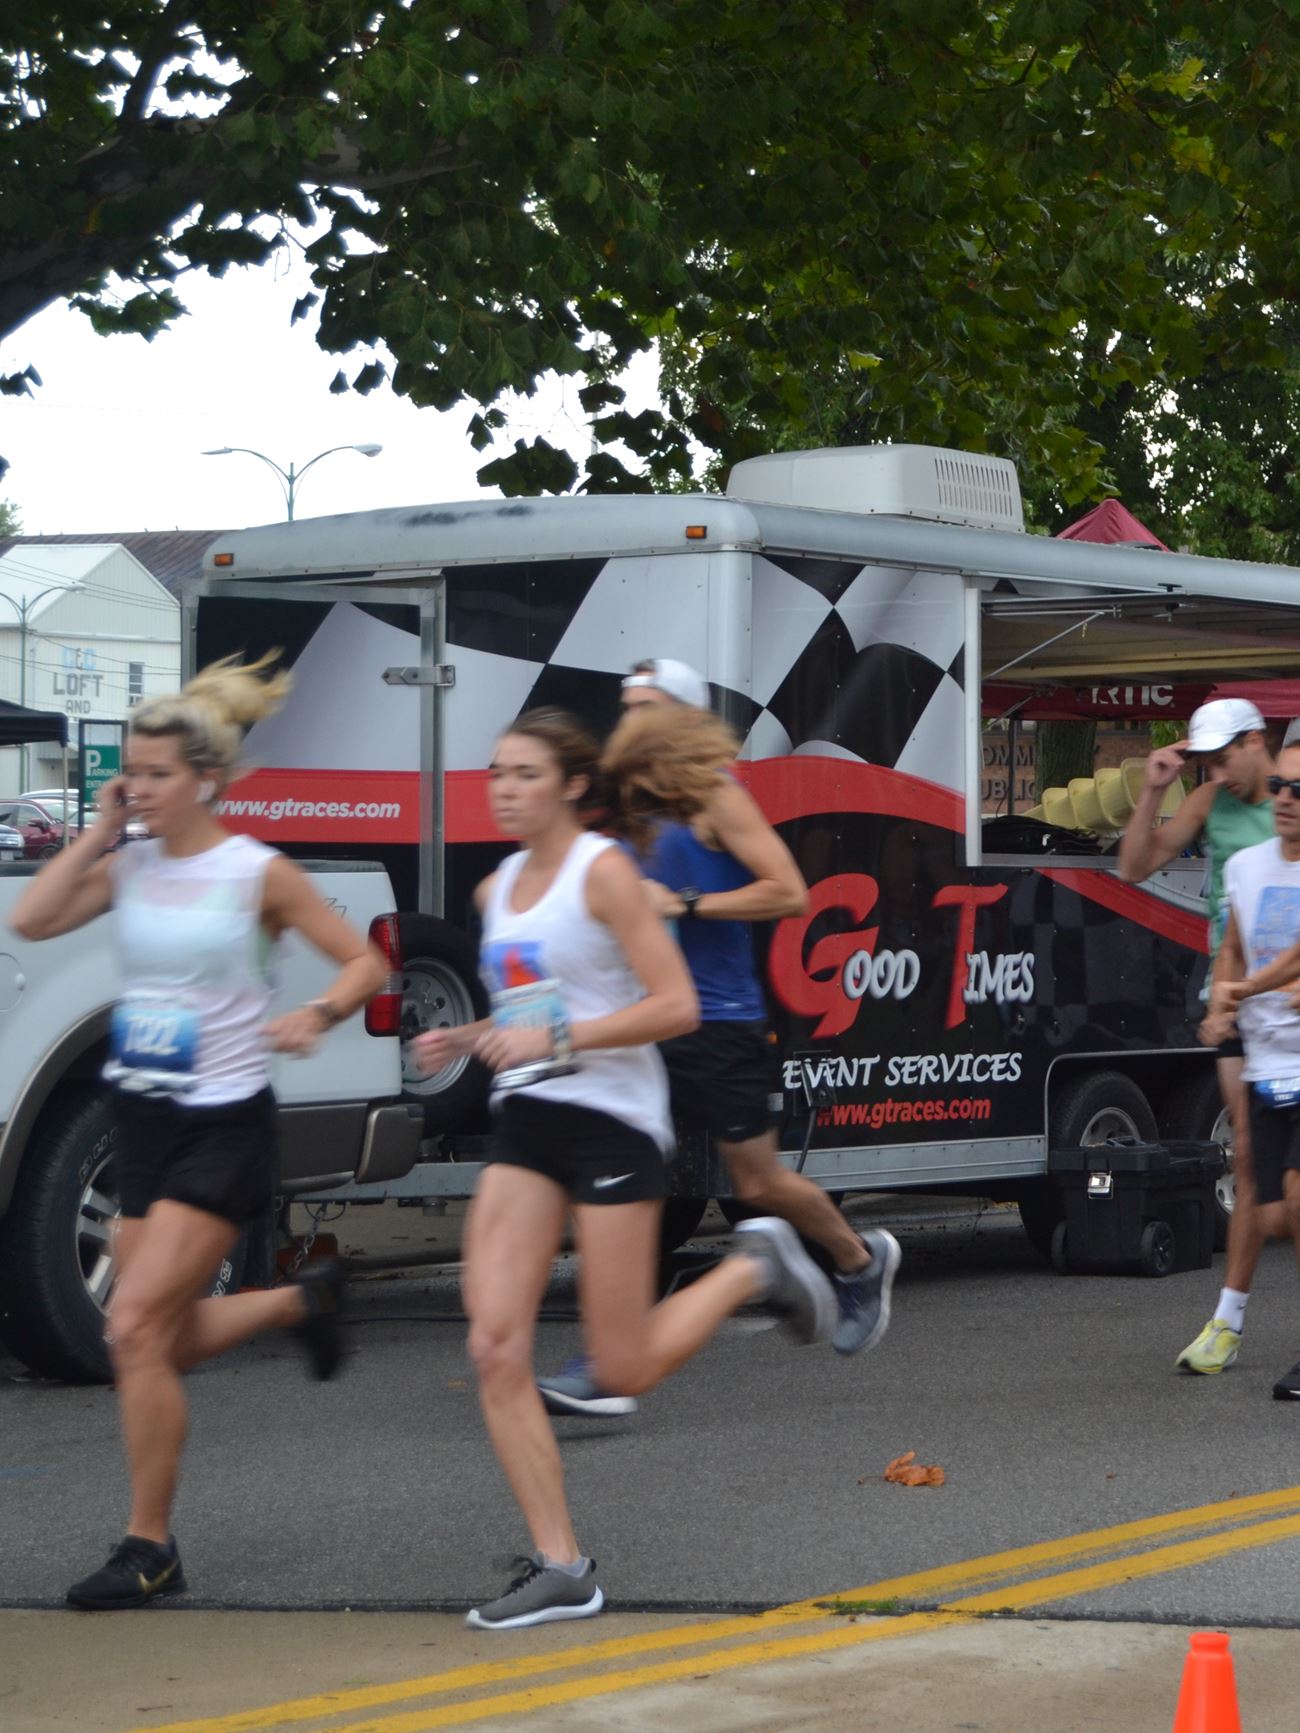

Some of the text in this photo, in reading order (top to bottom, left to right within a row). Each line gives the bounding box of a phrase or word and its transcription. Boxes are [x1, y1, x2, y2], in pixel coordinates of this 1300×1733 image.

[53, 672, 103, 697] LOFT
[65, 699, 92, 714] AND
[86, 749, 119, 777] PARKING
[211, 798, 400, 820] www.gtraces.com
[768, 872, 1035, 1039] GOOD TIMES
[782, 1052, 1022, 1089] EVENT SERVICES
[816, 1098, 991, 1128] www.gtraces.com
